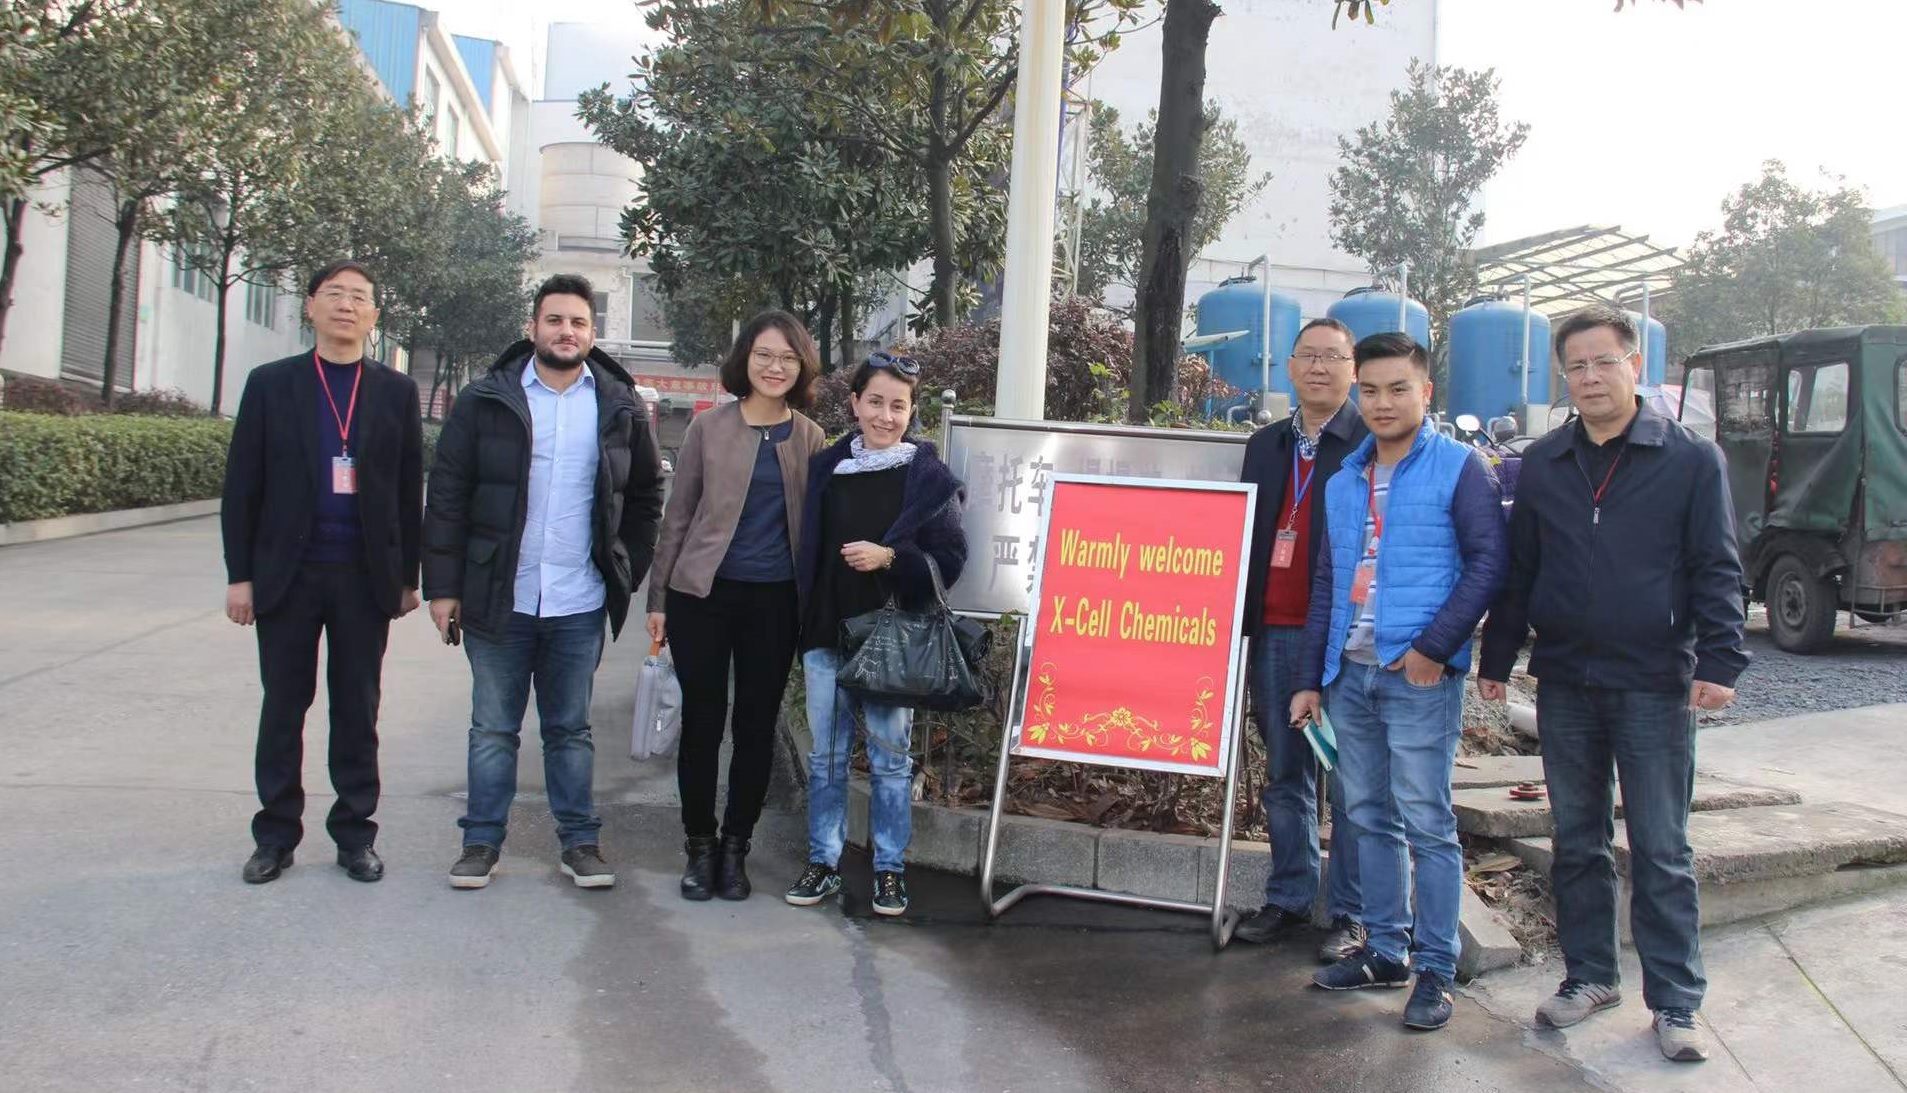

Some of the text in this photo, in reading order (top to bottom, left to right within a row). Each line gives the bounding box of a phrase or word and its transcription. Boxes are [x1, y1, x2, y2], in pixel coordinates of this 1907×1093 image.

[1060, 528, 1131, 579] Warmly
[1139, 535, 1224, 576] welcome
[1050, 595, 1217, 646] X-Cell Chemicals
